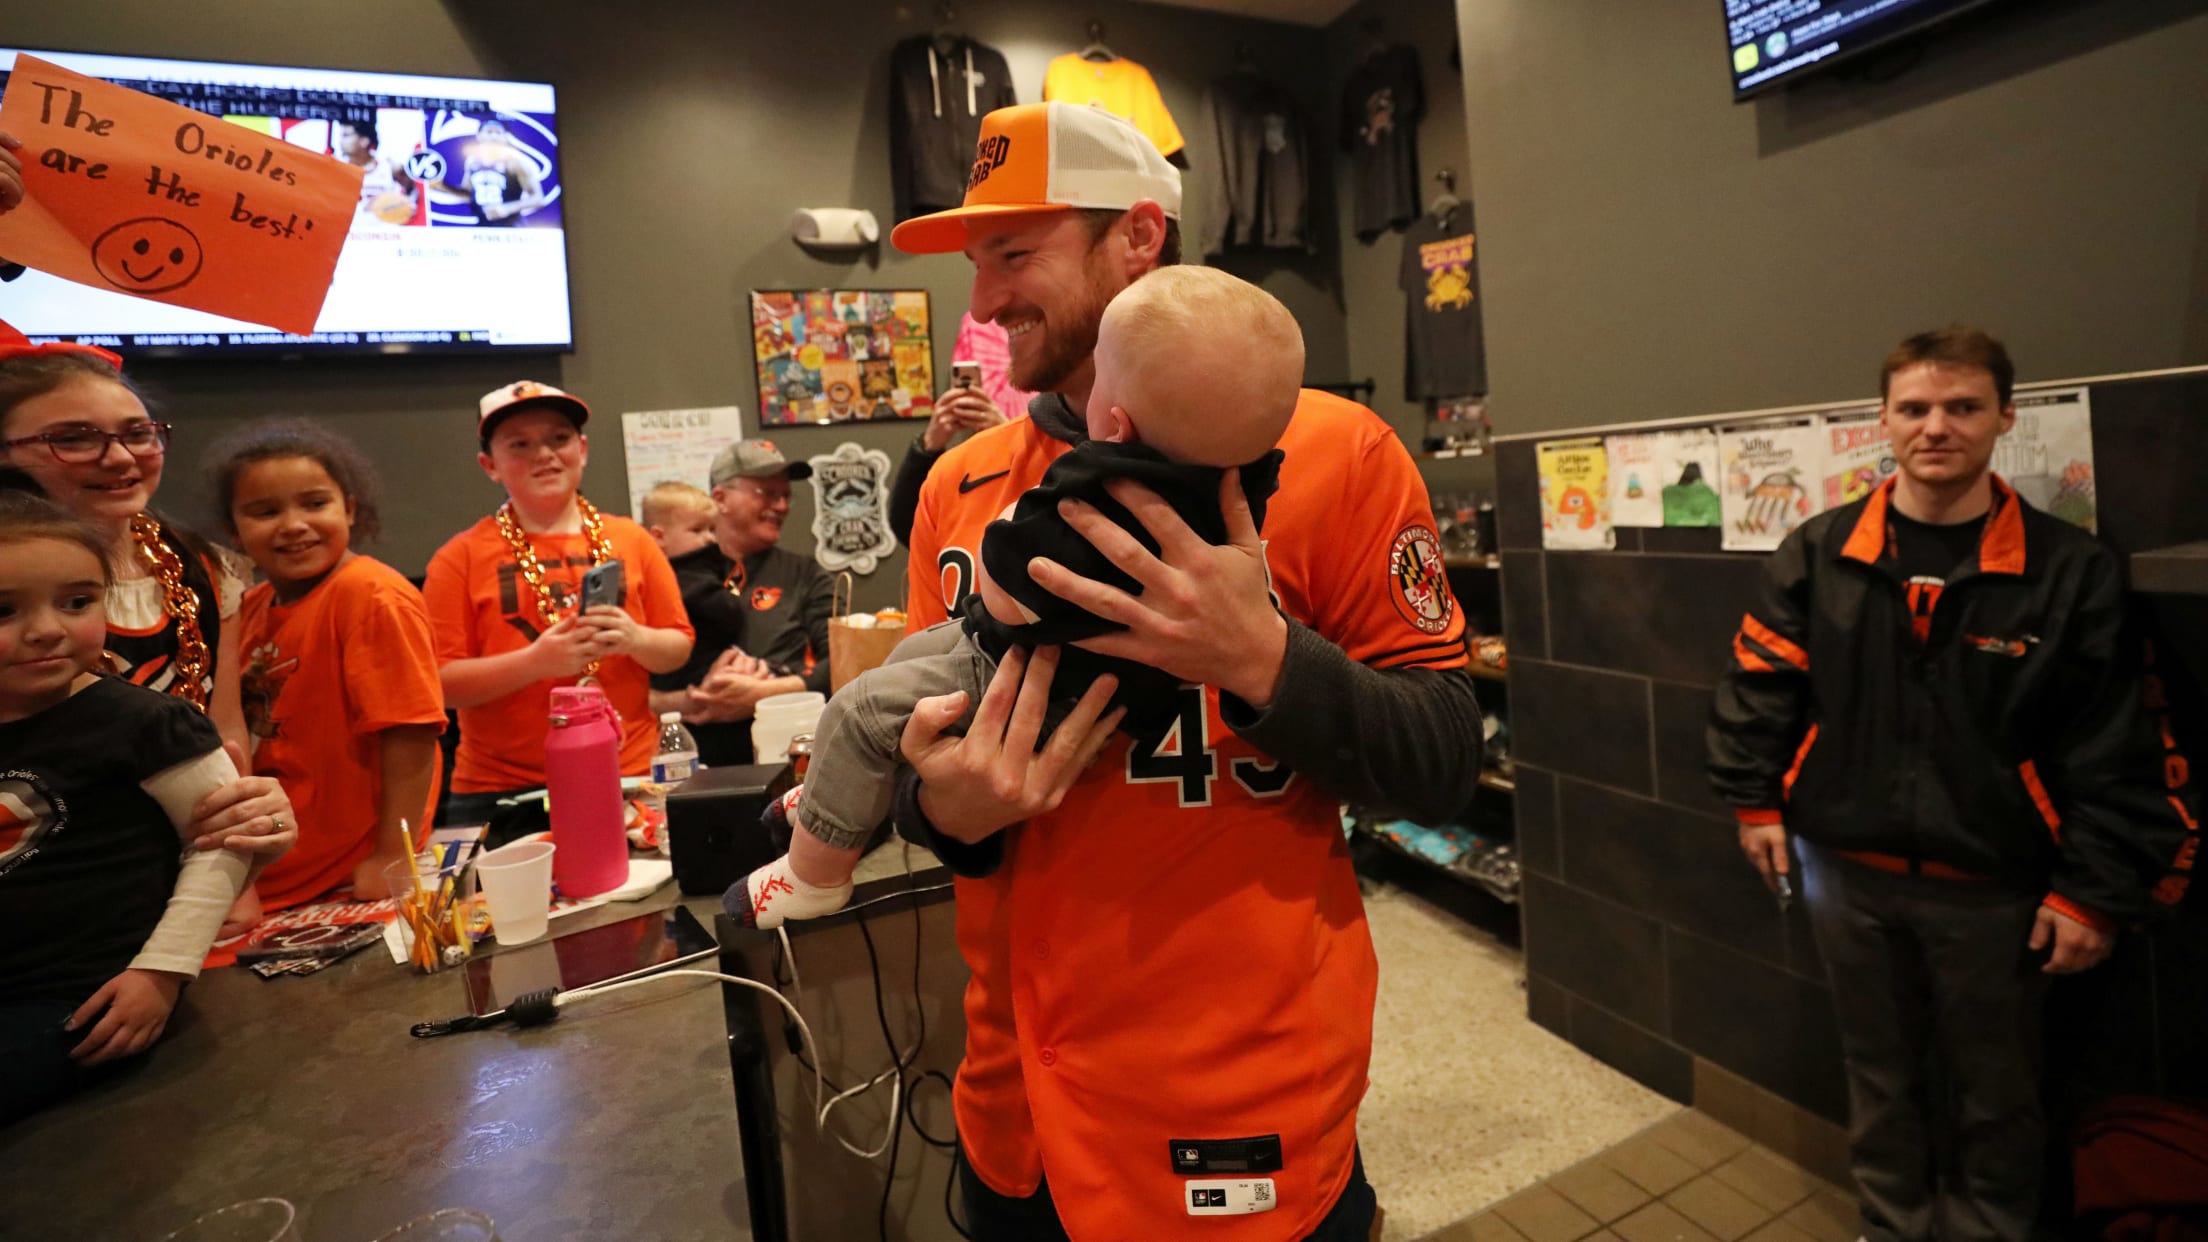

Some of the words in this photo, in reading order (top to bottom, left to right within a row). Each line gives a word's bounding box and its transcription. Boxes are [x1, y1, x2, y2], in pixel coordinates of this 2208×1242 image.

[31, 80, 115, 137] The
[174, 121, 298, 187] Orioles
[40, 147, 108, 180] are
[144, 165, 201, 208] the
[408, 152, 442, 178] VS
